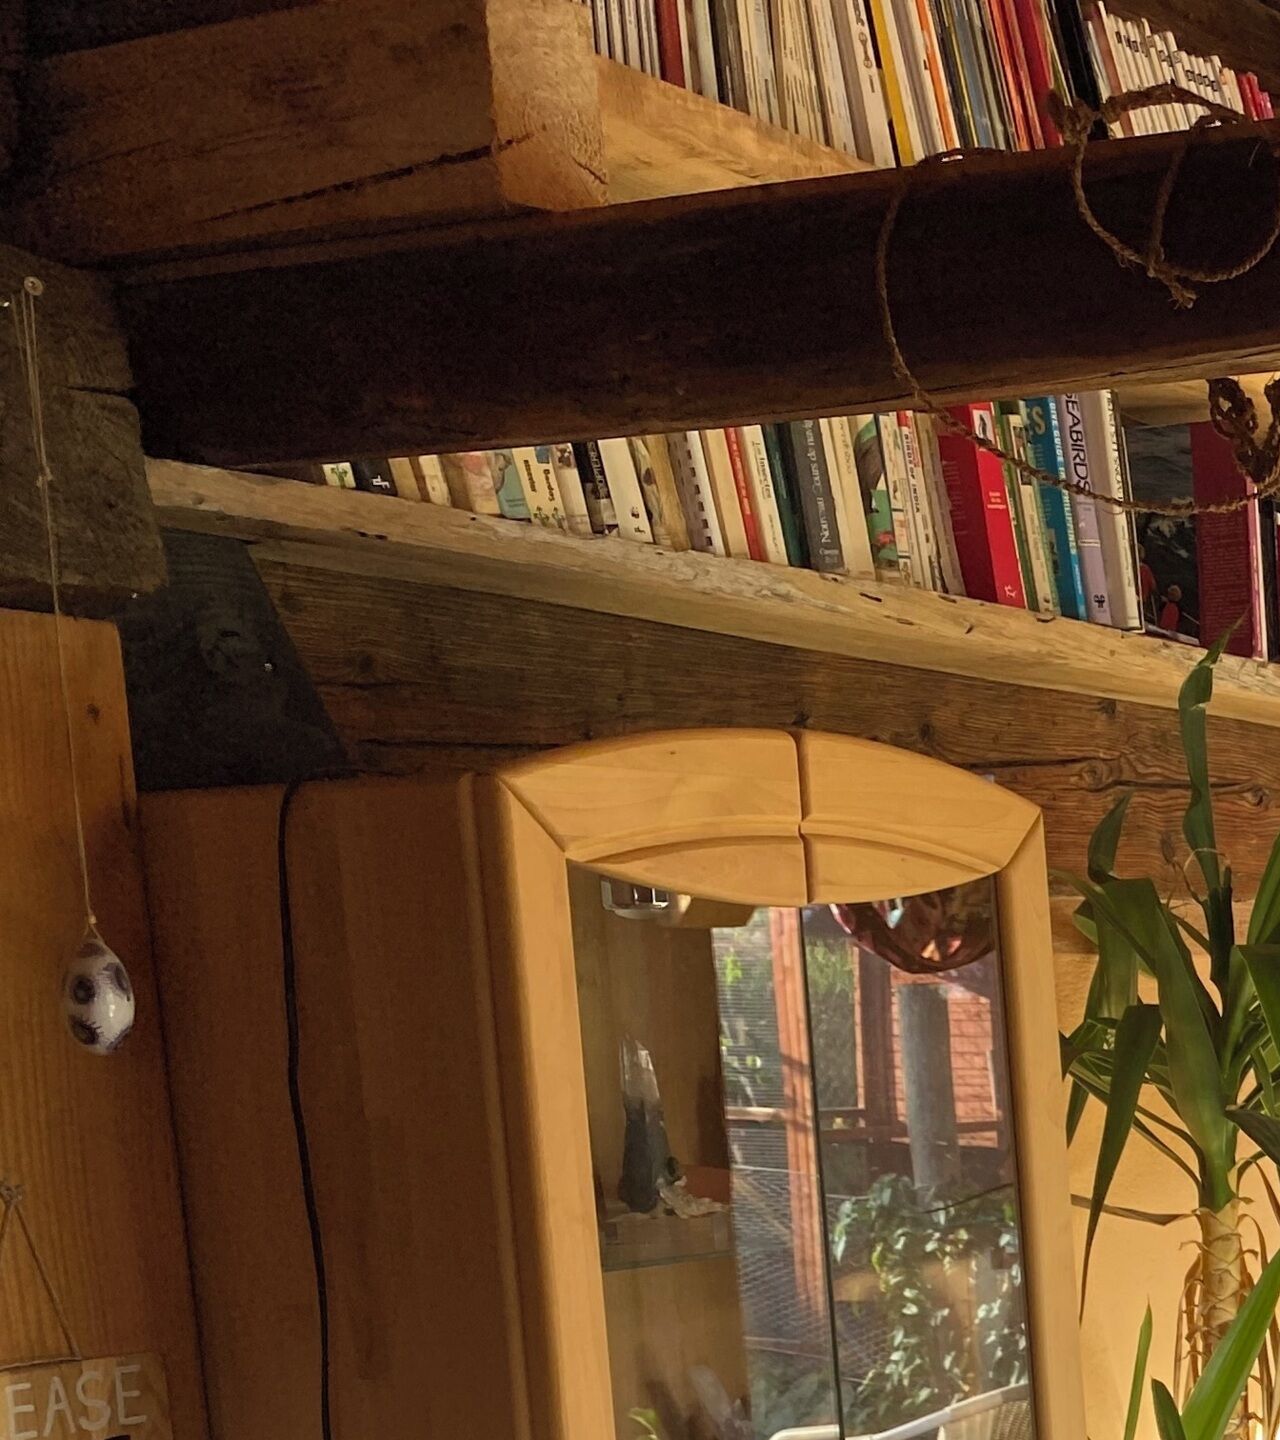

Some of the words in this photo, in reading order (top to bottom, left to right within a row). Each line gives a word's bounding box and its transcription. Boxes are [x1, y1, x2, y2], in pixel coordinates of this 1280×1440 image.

[903, 433, 914, 466] BIRDS
[1065, 392, 1091, 492] SEABIRDS
[909, 467, 916, 480] OF
[912, 483, 920, 513] INDIA
[1053, 428, 1064, 460] GUIDE
[1062, 489, 1077, 554] PHILIPPINES
